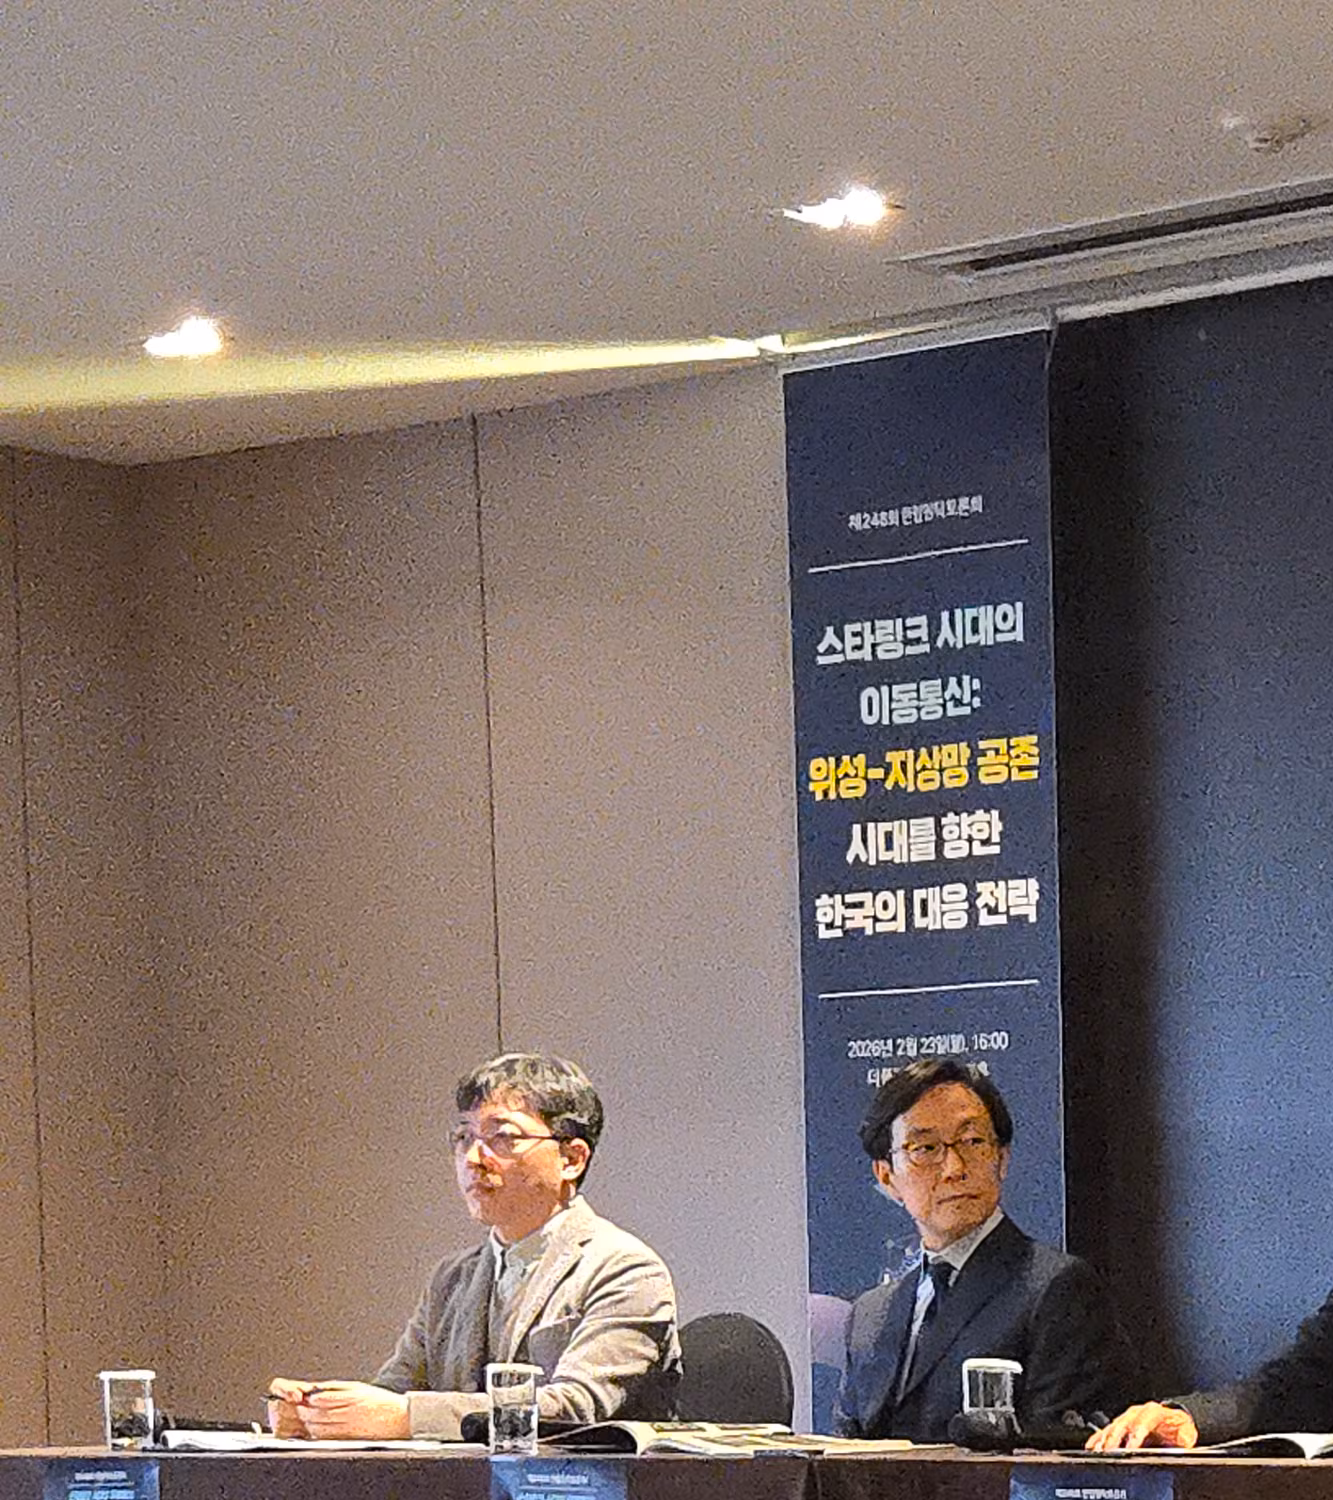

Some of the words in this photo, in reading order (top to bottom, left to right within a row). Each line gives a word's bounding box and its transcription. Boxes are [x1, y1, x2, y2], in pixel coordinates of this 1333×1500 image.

[816, 614, 931, 665] 스타링크
[936, 601, 1025, 650] 시대의
[859, 674, 982, 725] 이동통신:
[808, 741, 971, 802] 위성-지상망
[977, 734, 1041, 785] 공존
[846, 815, 937, 866] 시대를
[941, 808, 1003, 860] 향한
[814, 888, 907, 940] 한국의
[912, 881, 970, 931] 대응
[975, 876, 1041, 928] 전략
[847, 1037, 894, 1059] 2026년
